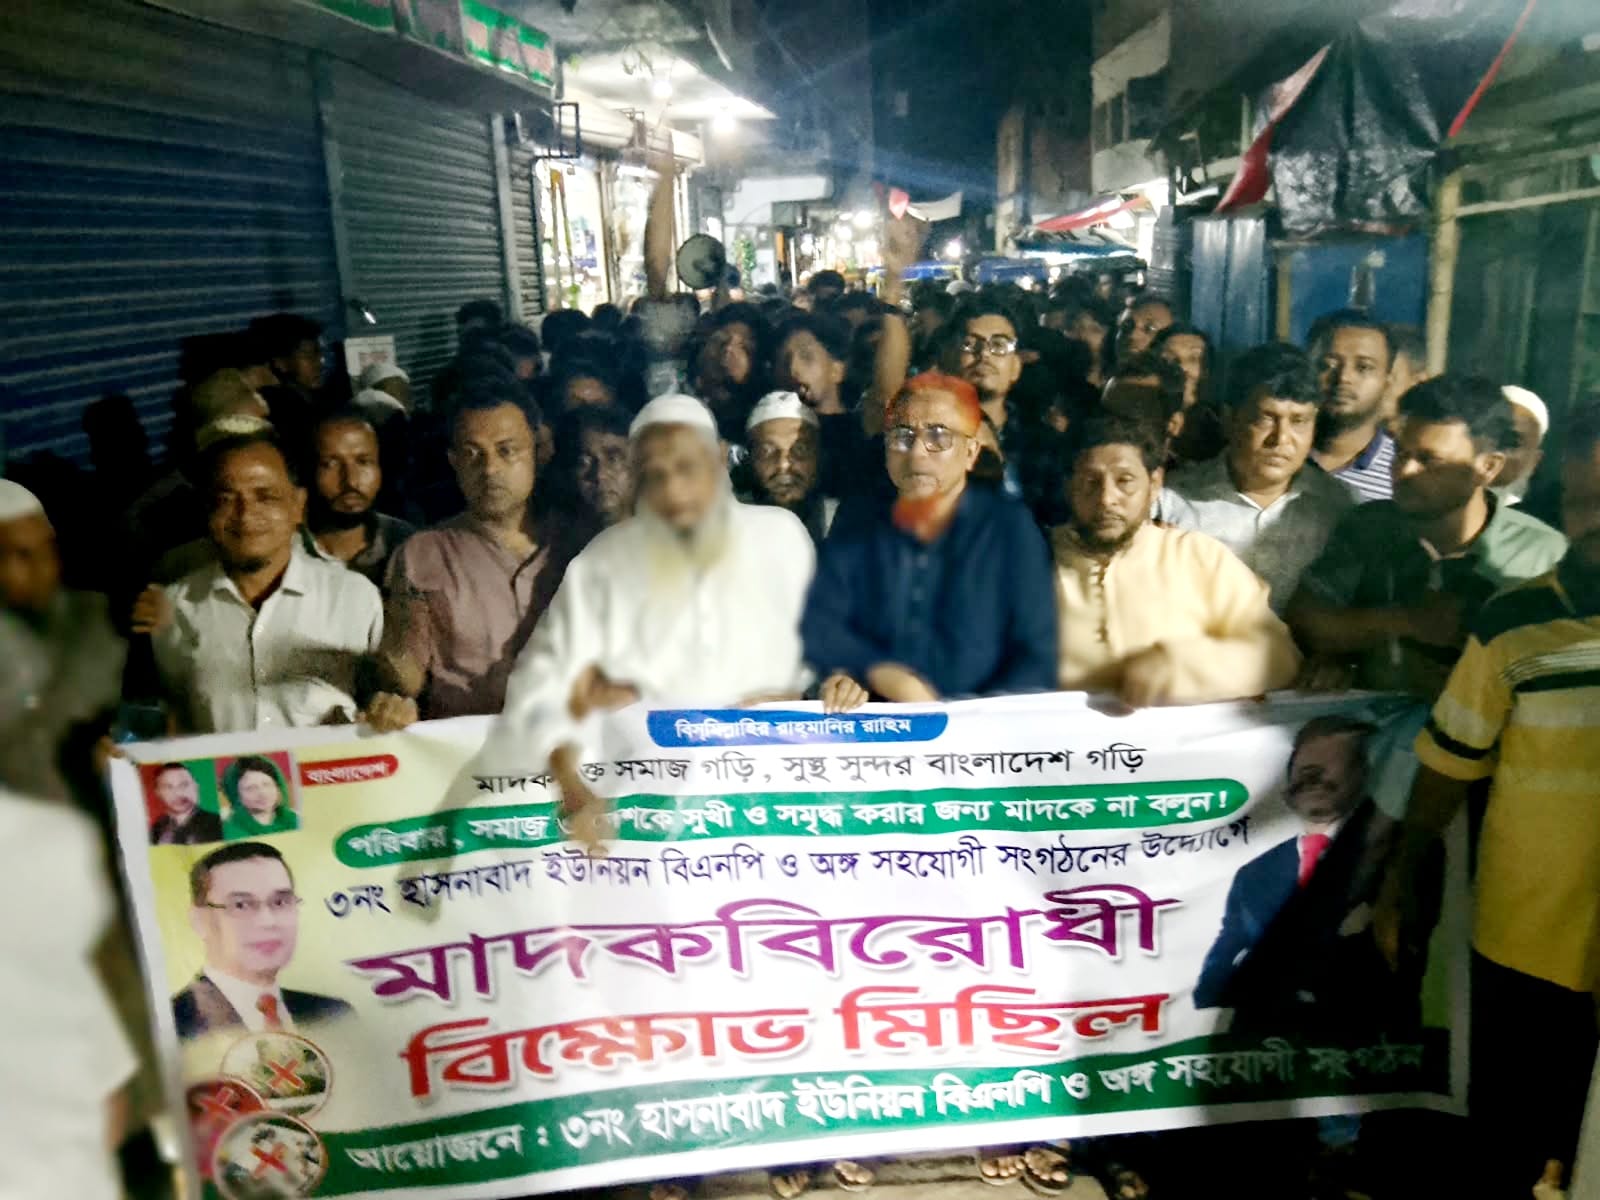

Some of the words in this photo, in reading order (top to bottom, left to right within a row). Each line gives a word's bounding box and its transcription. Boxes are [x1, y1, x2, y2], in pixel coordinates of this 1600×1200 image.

[467, 815, 549, 840] সমাজ
[682, 800, 736, 836] সুখী
[743, 807, 767, 826] ও
[773, 803, 845, 835] সমৃদ্ধ
[853, 802, 926, 826] করার
[931, 800, 994, 822] জন্য
[1000, 797, 1097, 822] মাদকে
[1103, 794, 1137, 818] না
[614, 758, 692, 783] সমাজ
[781, 756, 831, 783] সুস্থ
[836, 754, 914, 783] সুন্দর
[924, 750, 1074, 778] বাংলাদেশ
[1087, 743, 1148, 774] গড়ি
[324, 884, 392, 918] ৩নং
[397, 858, 533, 908] হাসনাবাদ
[541, 846, 651, 888] ইউনিয়ন
[659, 842, 765, 887] বিএনপি
[776, 853, 799, 878] ও
[809, 852, 861, 881] অঙ্গ
[869, 834, 987, 880] সহযোগী
[995, 834, 1132, 875] সংগঠনের
[1140, 815, 1251, 858] উদ্যোগে
[344, 884, 1186, 1002] মাদকবিরোধী
[399, 1003, 810, 1098] বিক্ষোভ
[835, 985, 1172, 1053] মিছিল
[345, 1122, 525, 1173] আয়োজনে
[560, 1111, 632, 1150] ৩নং
[636, 1089, 788, 1141] হাসনাবাদ
[792, 1074, 927, 1126] ইউনিয়ন
[930, 1068, 1055, 1116] বিএনপি
[1062, 1071, 1091, 1099] ও
[1098, 1060, 1159, 1094] অঙ্গ
[1163, 1036, 1298, 1088] সহযোগী
